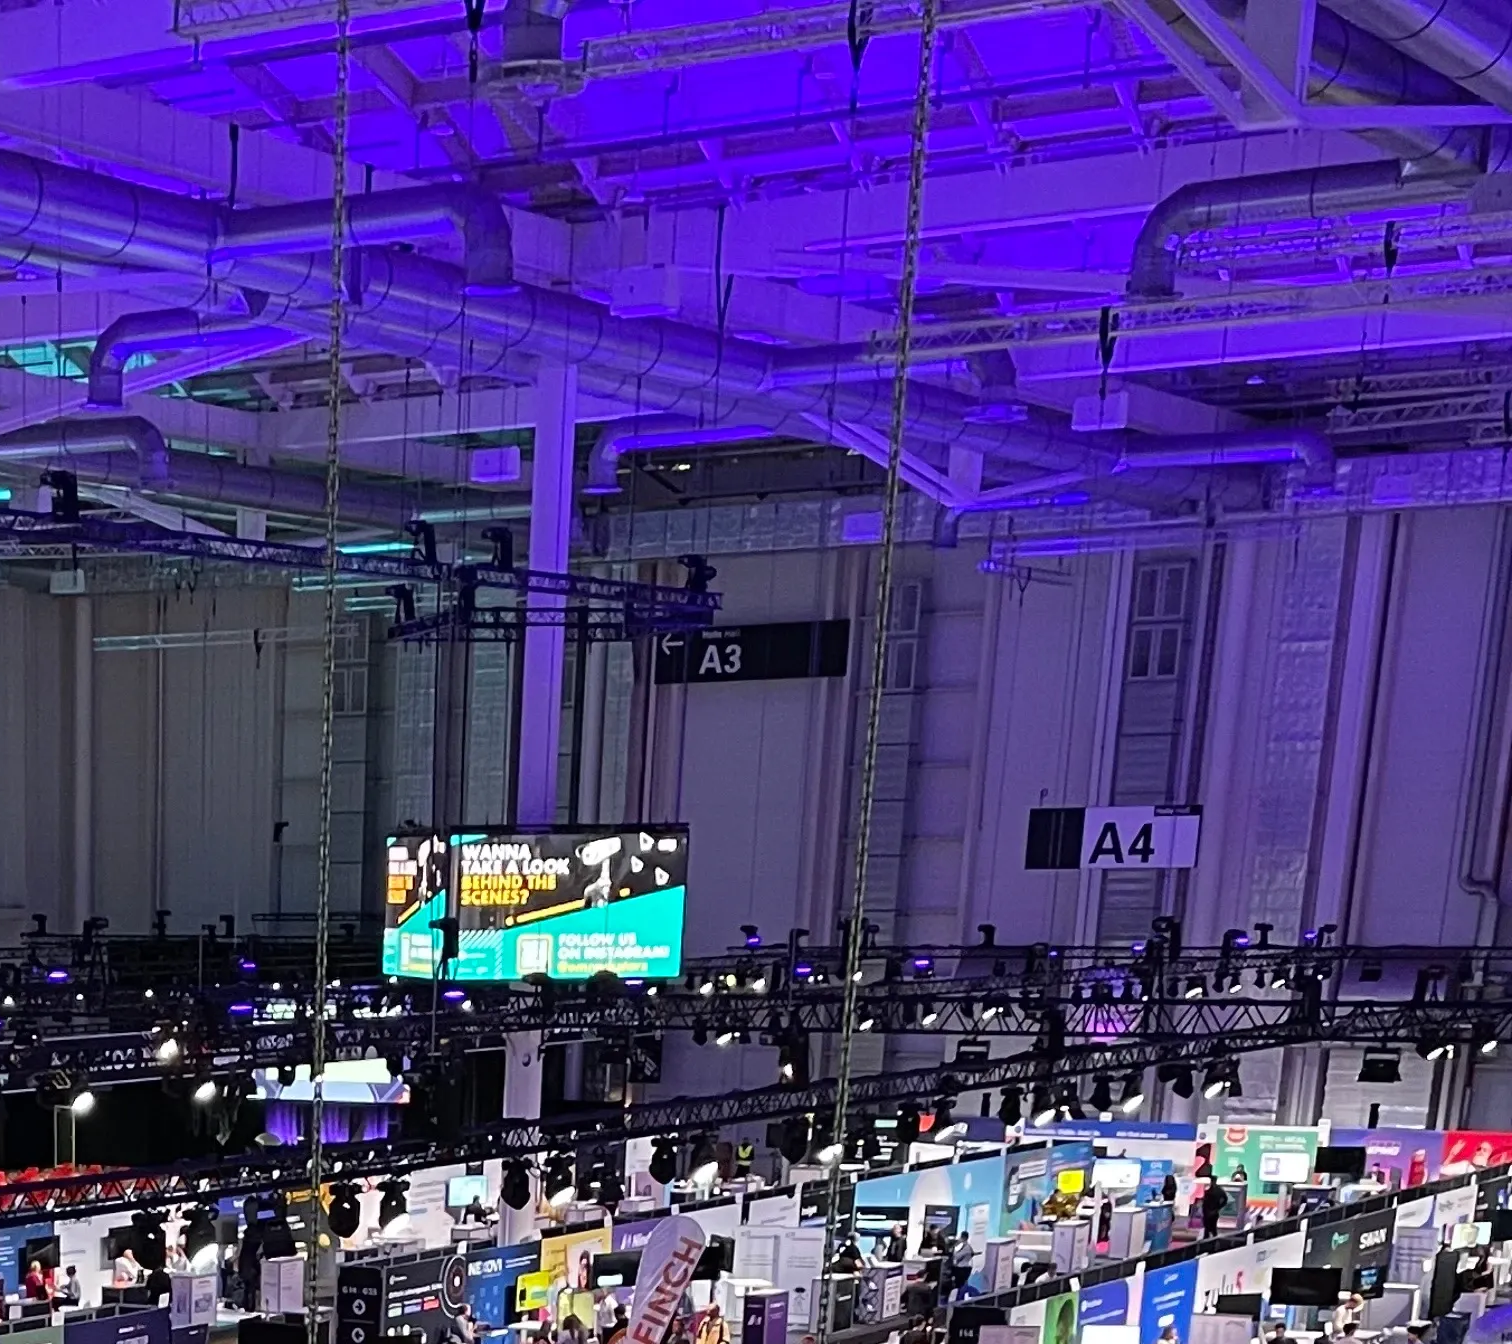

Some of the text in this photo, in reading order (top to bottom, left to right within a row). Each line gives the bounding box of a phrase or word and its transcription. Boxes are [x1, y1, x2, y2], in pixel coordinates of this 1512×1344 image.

[699, 644, 742, 674] A3
[1089, 822, 1155, 864] A4
[461, 843, 532, 861] WANNA
[461, 858, 570, 875] TAKE A LOOK
[461, 874, 558, 891] BEHIND THE
[461, 890, 529, 906] SCENES?
[558, 933, 616, 948] FOLLOW
